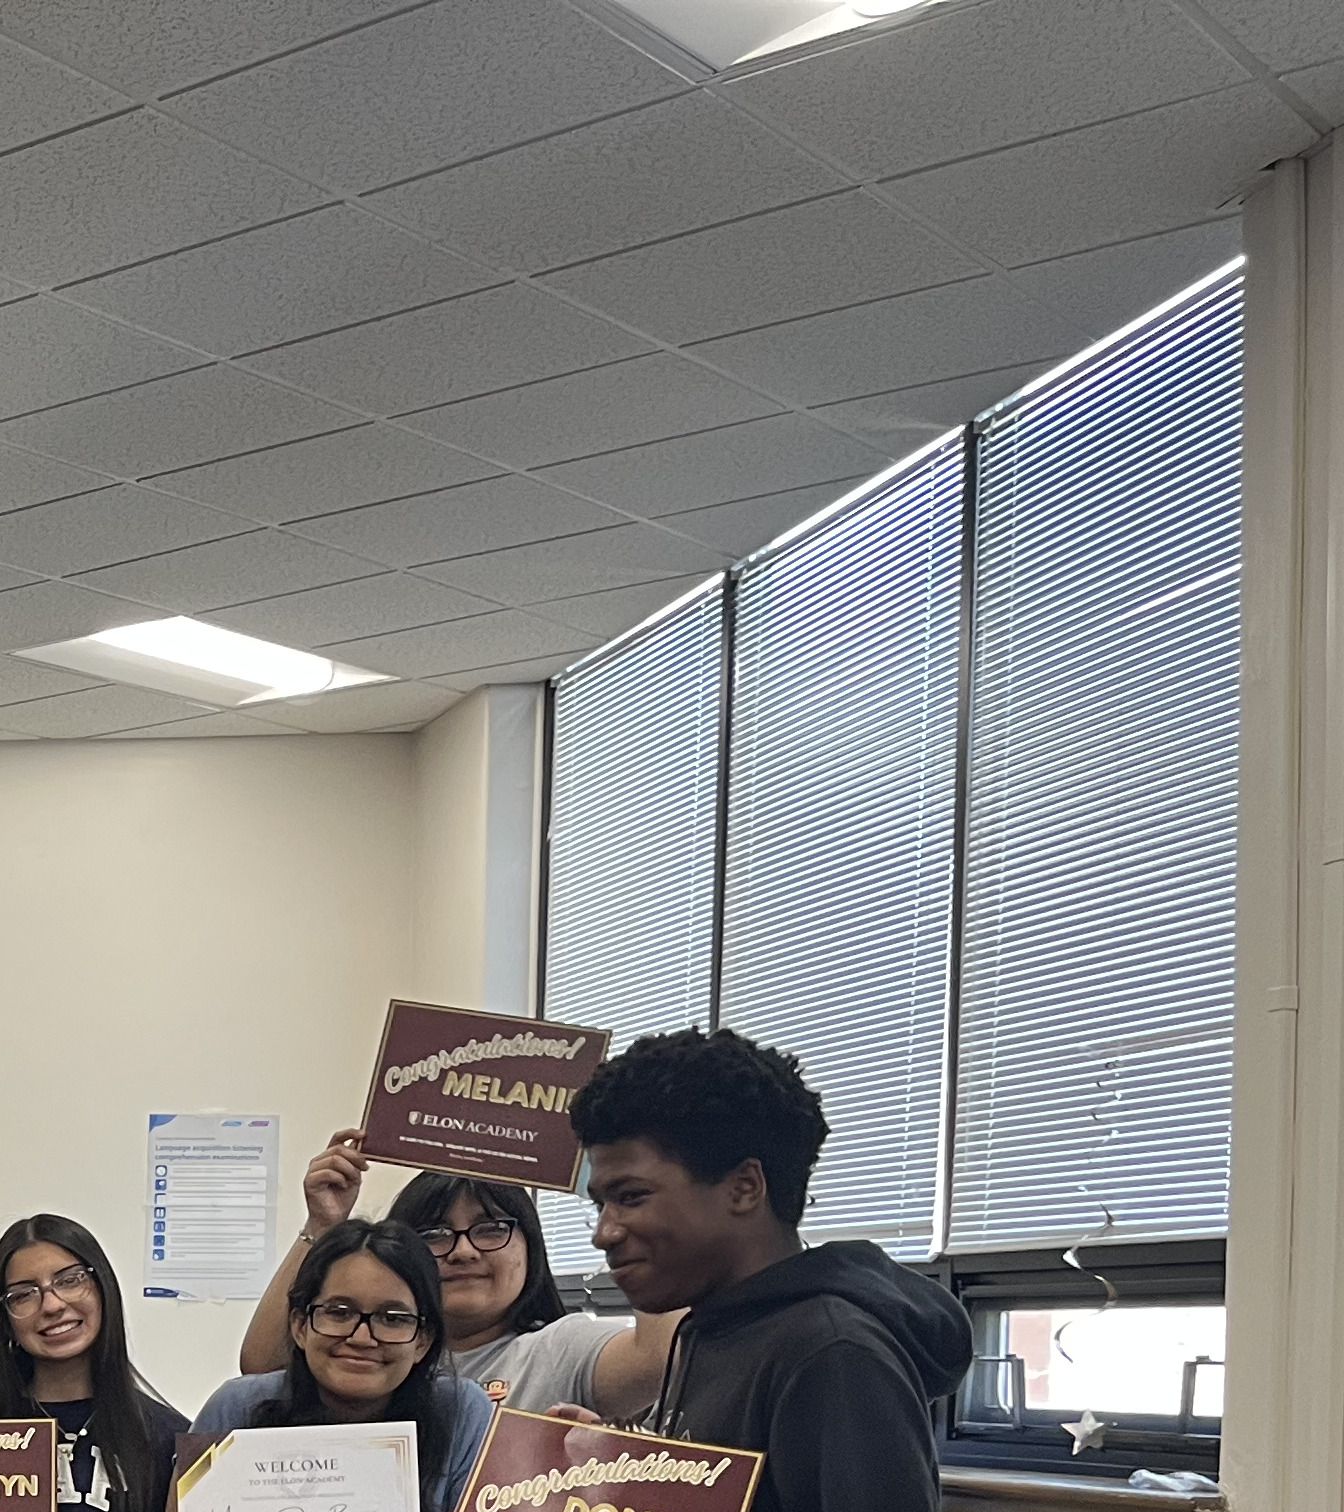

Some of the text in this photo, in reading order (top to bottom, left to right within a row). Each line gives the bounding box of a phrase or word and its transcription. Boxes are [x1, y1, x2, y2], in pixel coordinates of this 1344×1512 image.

[384, 1031, 586, 1094] Congratulations!
[442, 1071, 577, 1114] MELANI
[422, 1114, 539, 1142] ELON ACADEMY
[255, 1458, 339, 1473] WELCOME
